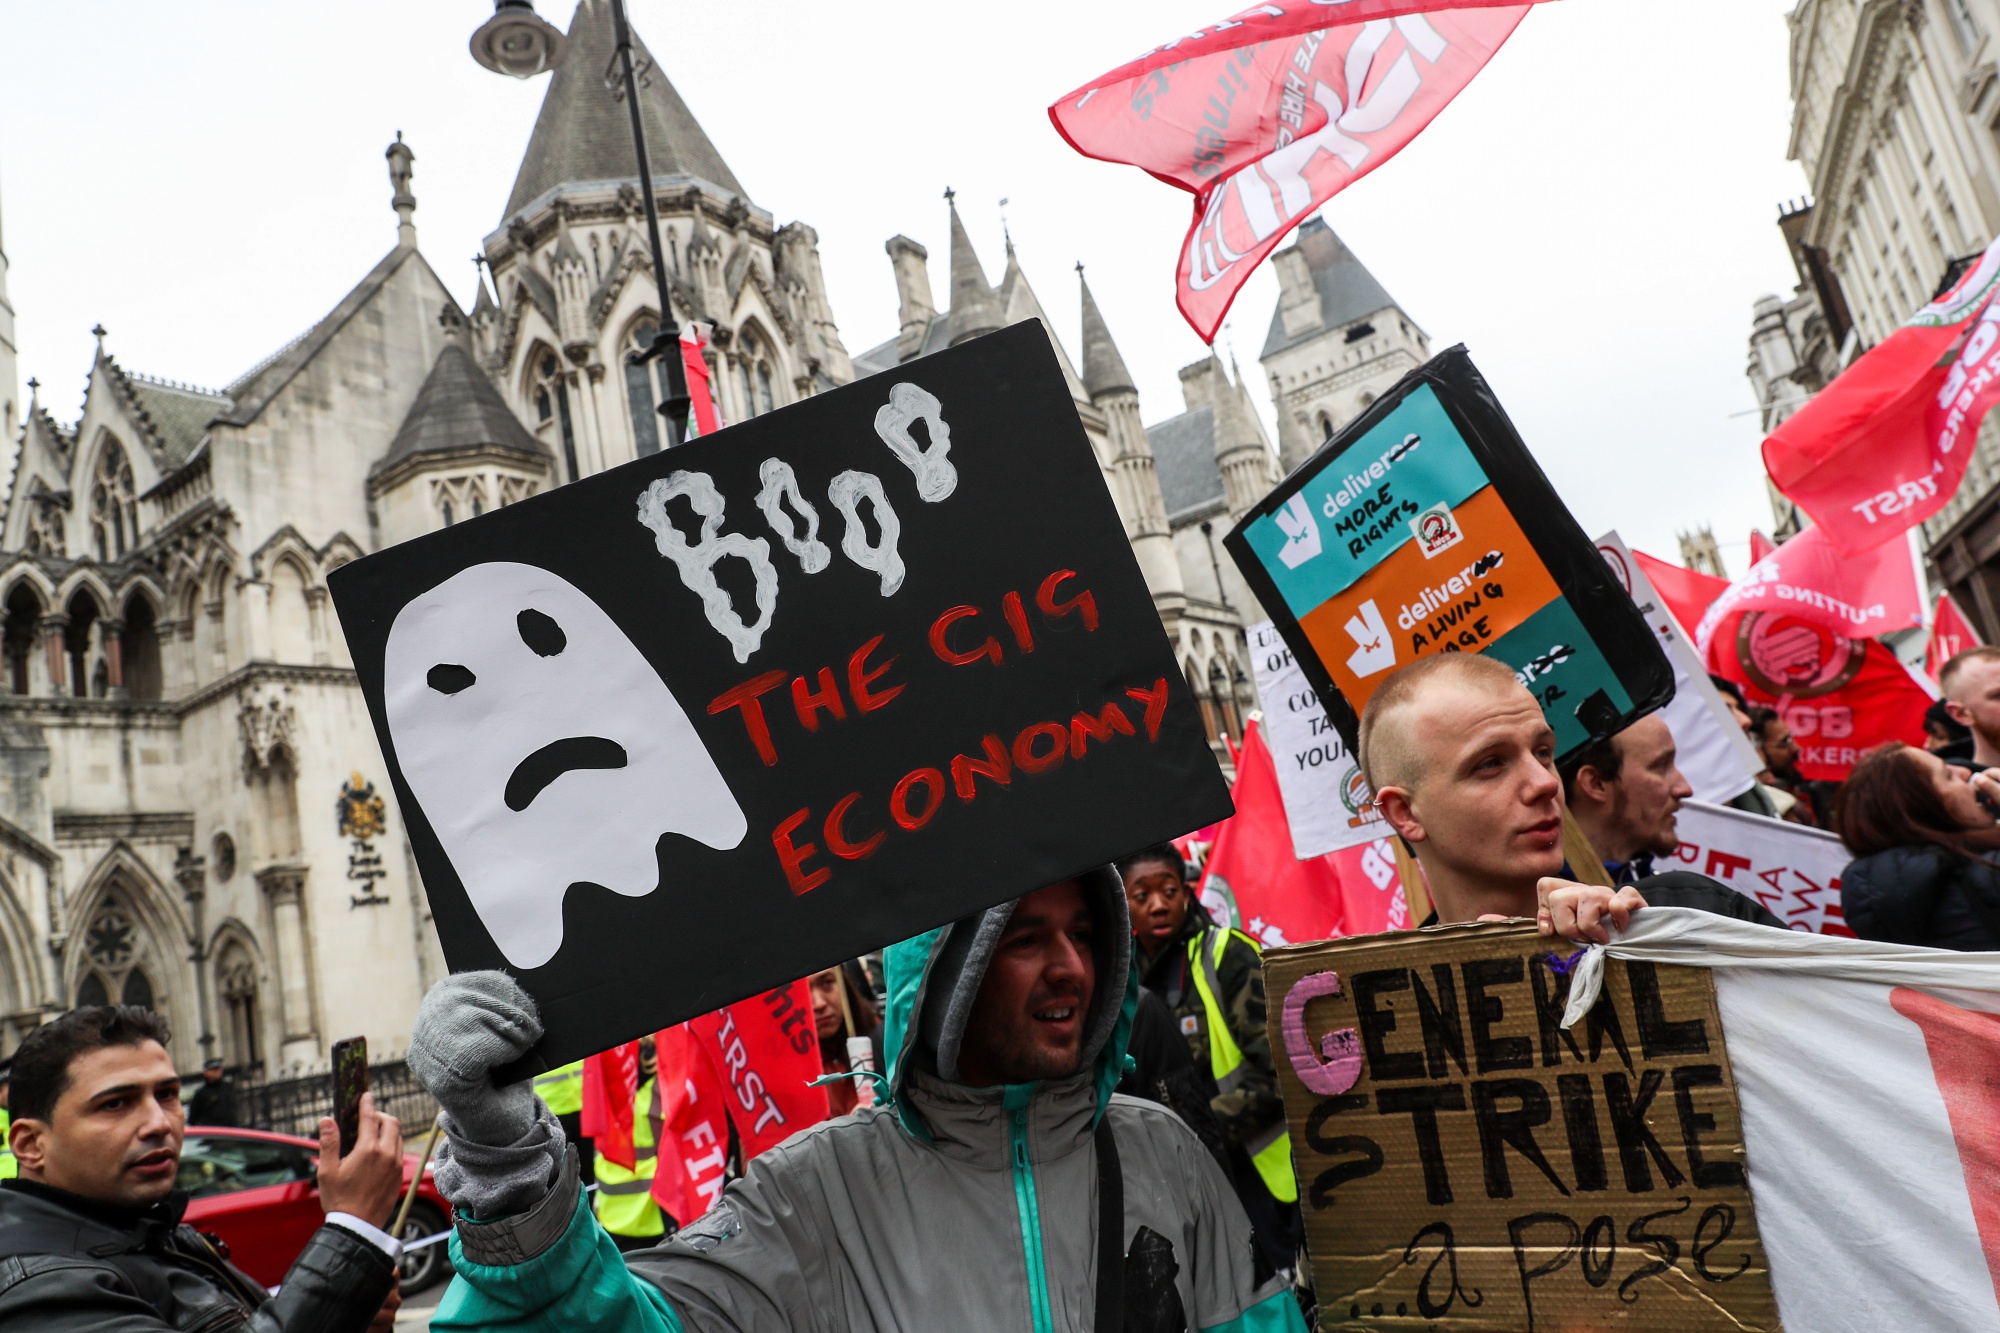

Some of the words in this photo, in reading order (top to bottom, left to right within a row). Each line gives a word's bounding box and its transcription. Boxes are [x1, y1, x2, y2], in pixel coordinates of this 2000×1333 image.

[1334, 482, 1394, 538] MORE
[1349, 499, 1419, 560] RIGHTS
[1412, 631, 1429, 654] A
[1427, 582, 1504, 641] LIVING
[706, 633, 908, 767] THE
[928, 568, 1100, 667] GIG
[771, 677, 1169, 897] ECONOMY
[351, 841, 375, 853] The
[361, 880, 376, 893] of
[1281, 952, 1710, 1096] GENERAL
[1304, 1063, 1746, 1210] STRIKE
